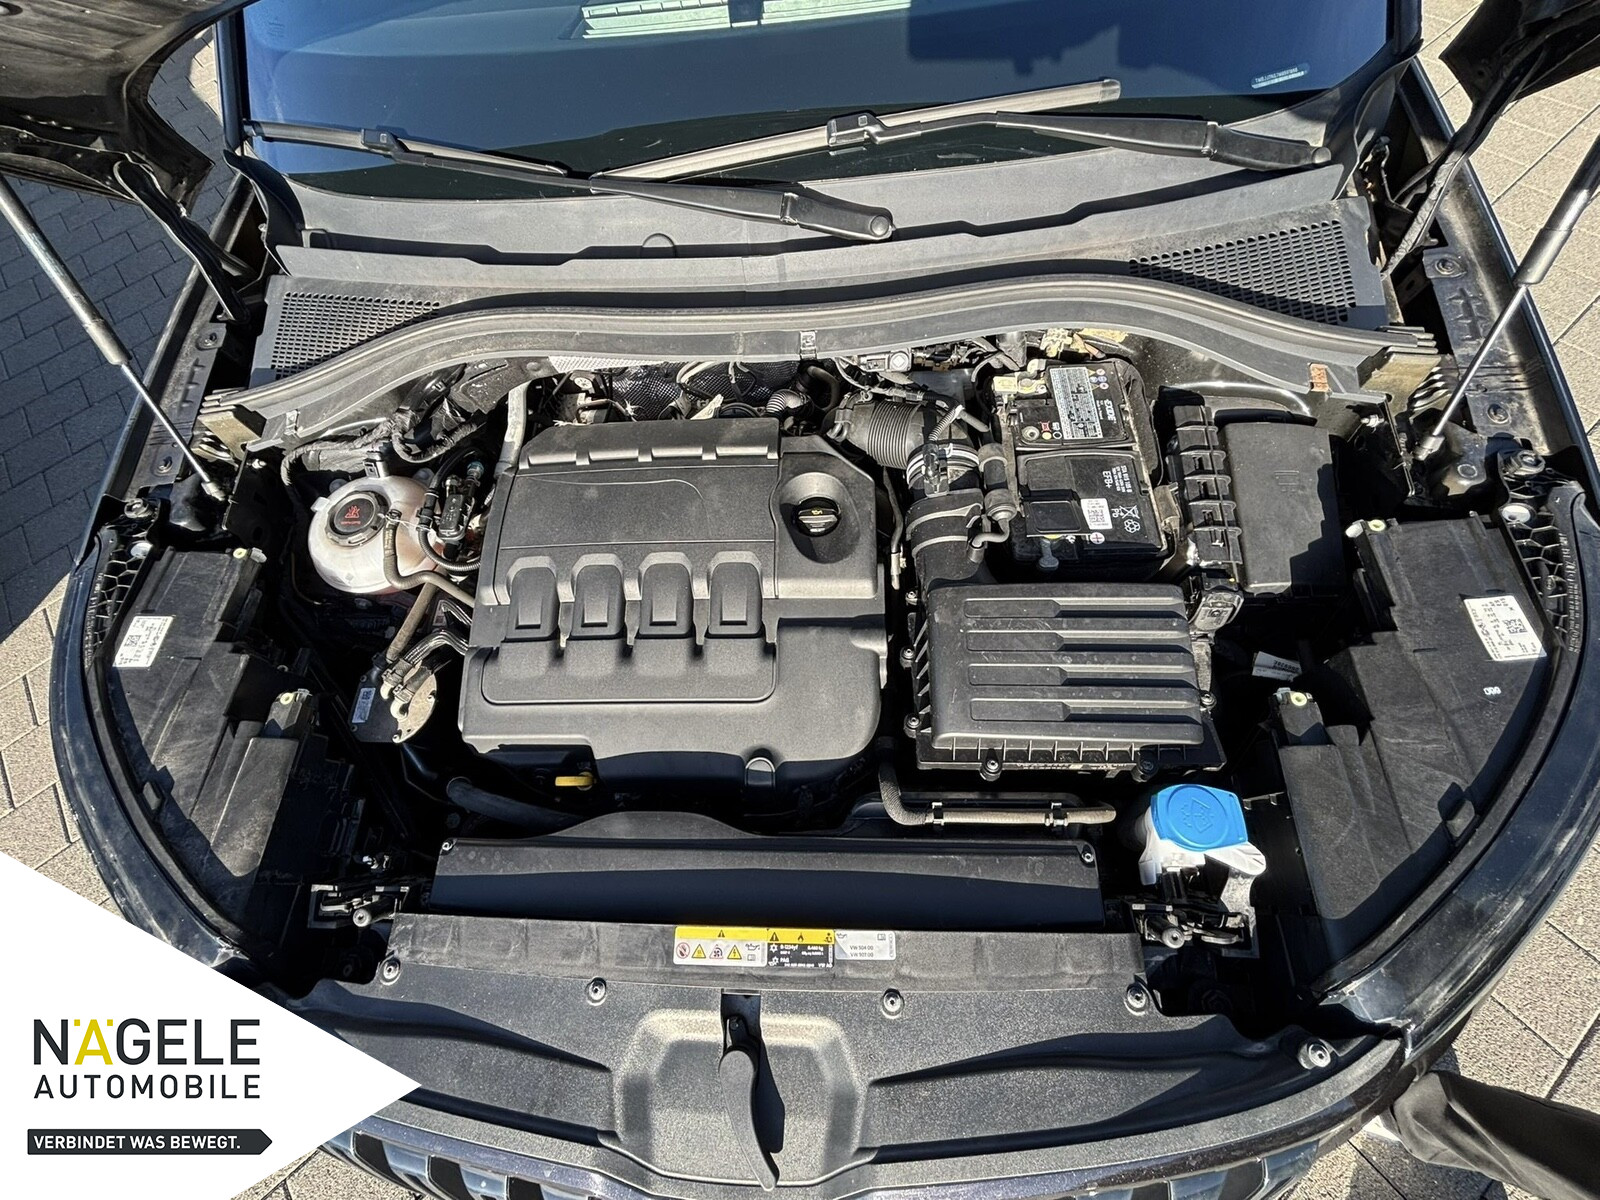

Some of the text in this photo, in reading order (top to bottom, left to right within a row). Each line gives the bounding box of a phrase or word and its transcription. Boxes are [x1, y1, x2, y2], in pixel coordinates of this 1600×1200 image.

[1104, 399, 1116, 421] EXIDE
[1102, 470, 1114, 488] EFB+
[1111, 508, 1120, 518] Pb
